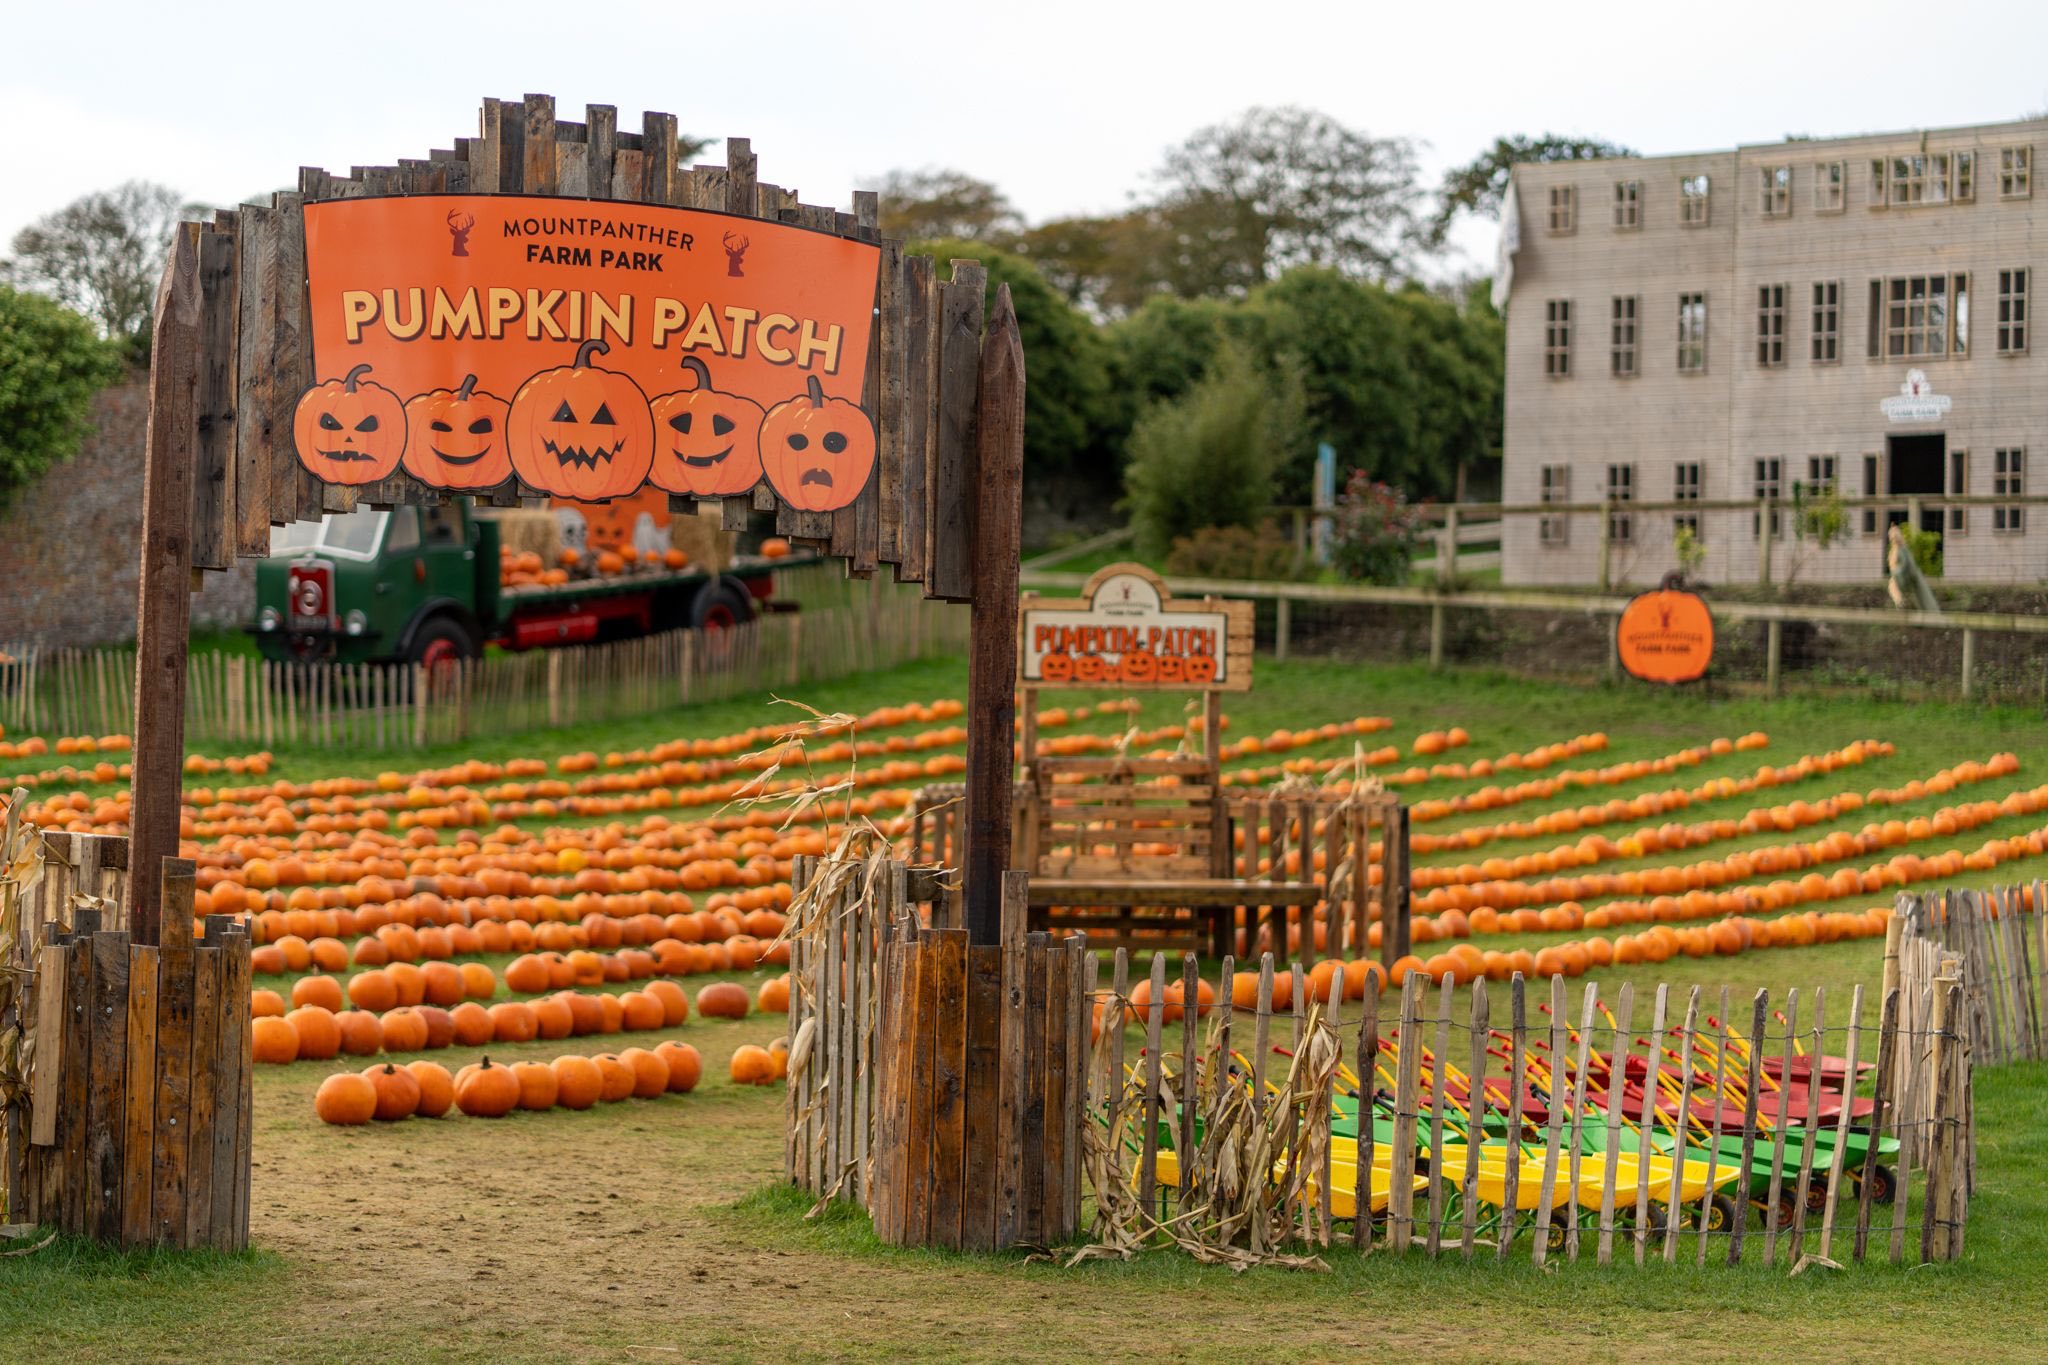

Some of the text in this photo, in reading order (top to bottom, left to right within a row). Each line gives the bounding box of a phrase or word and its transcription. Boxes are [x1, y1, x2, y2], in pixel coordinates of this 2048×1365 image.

[502, 217, 695, 252] MOUNTPANTHER
[526, 243, 664, 273] FARM PARK
[341, 286, 845, 376] PUMPKIN PATCH
[1148, 627, 1217, 656] PATCH
